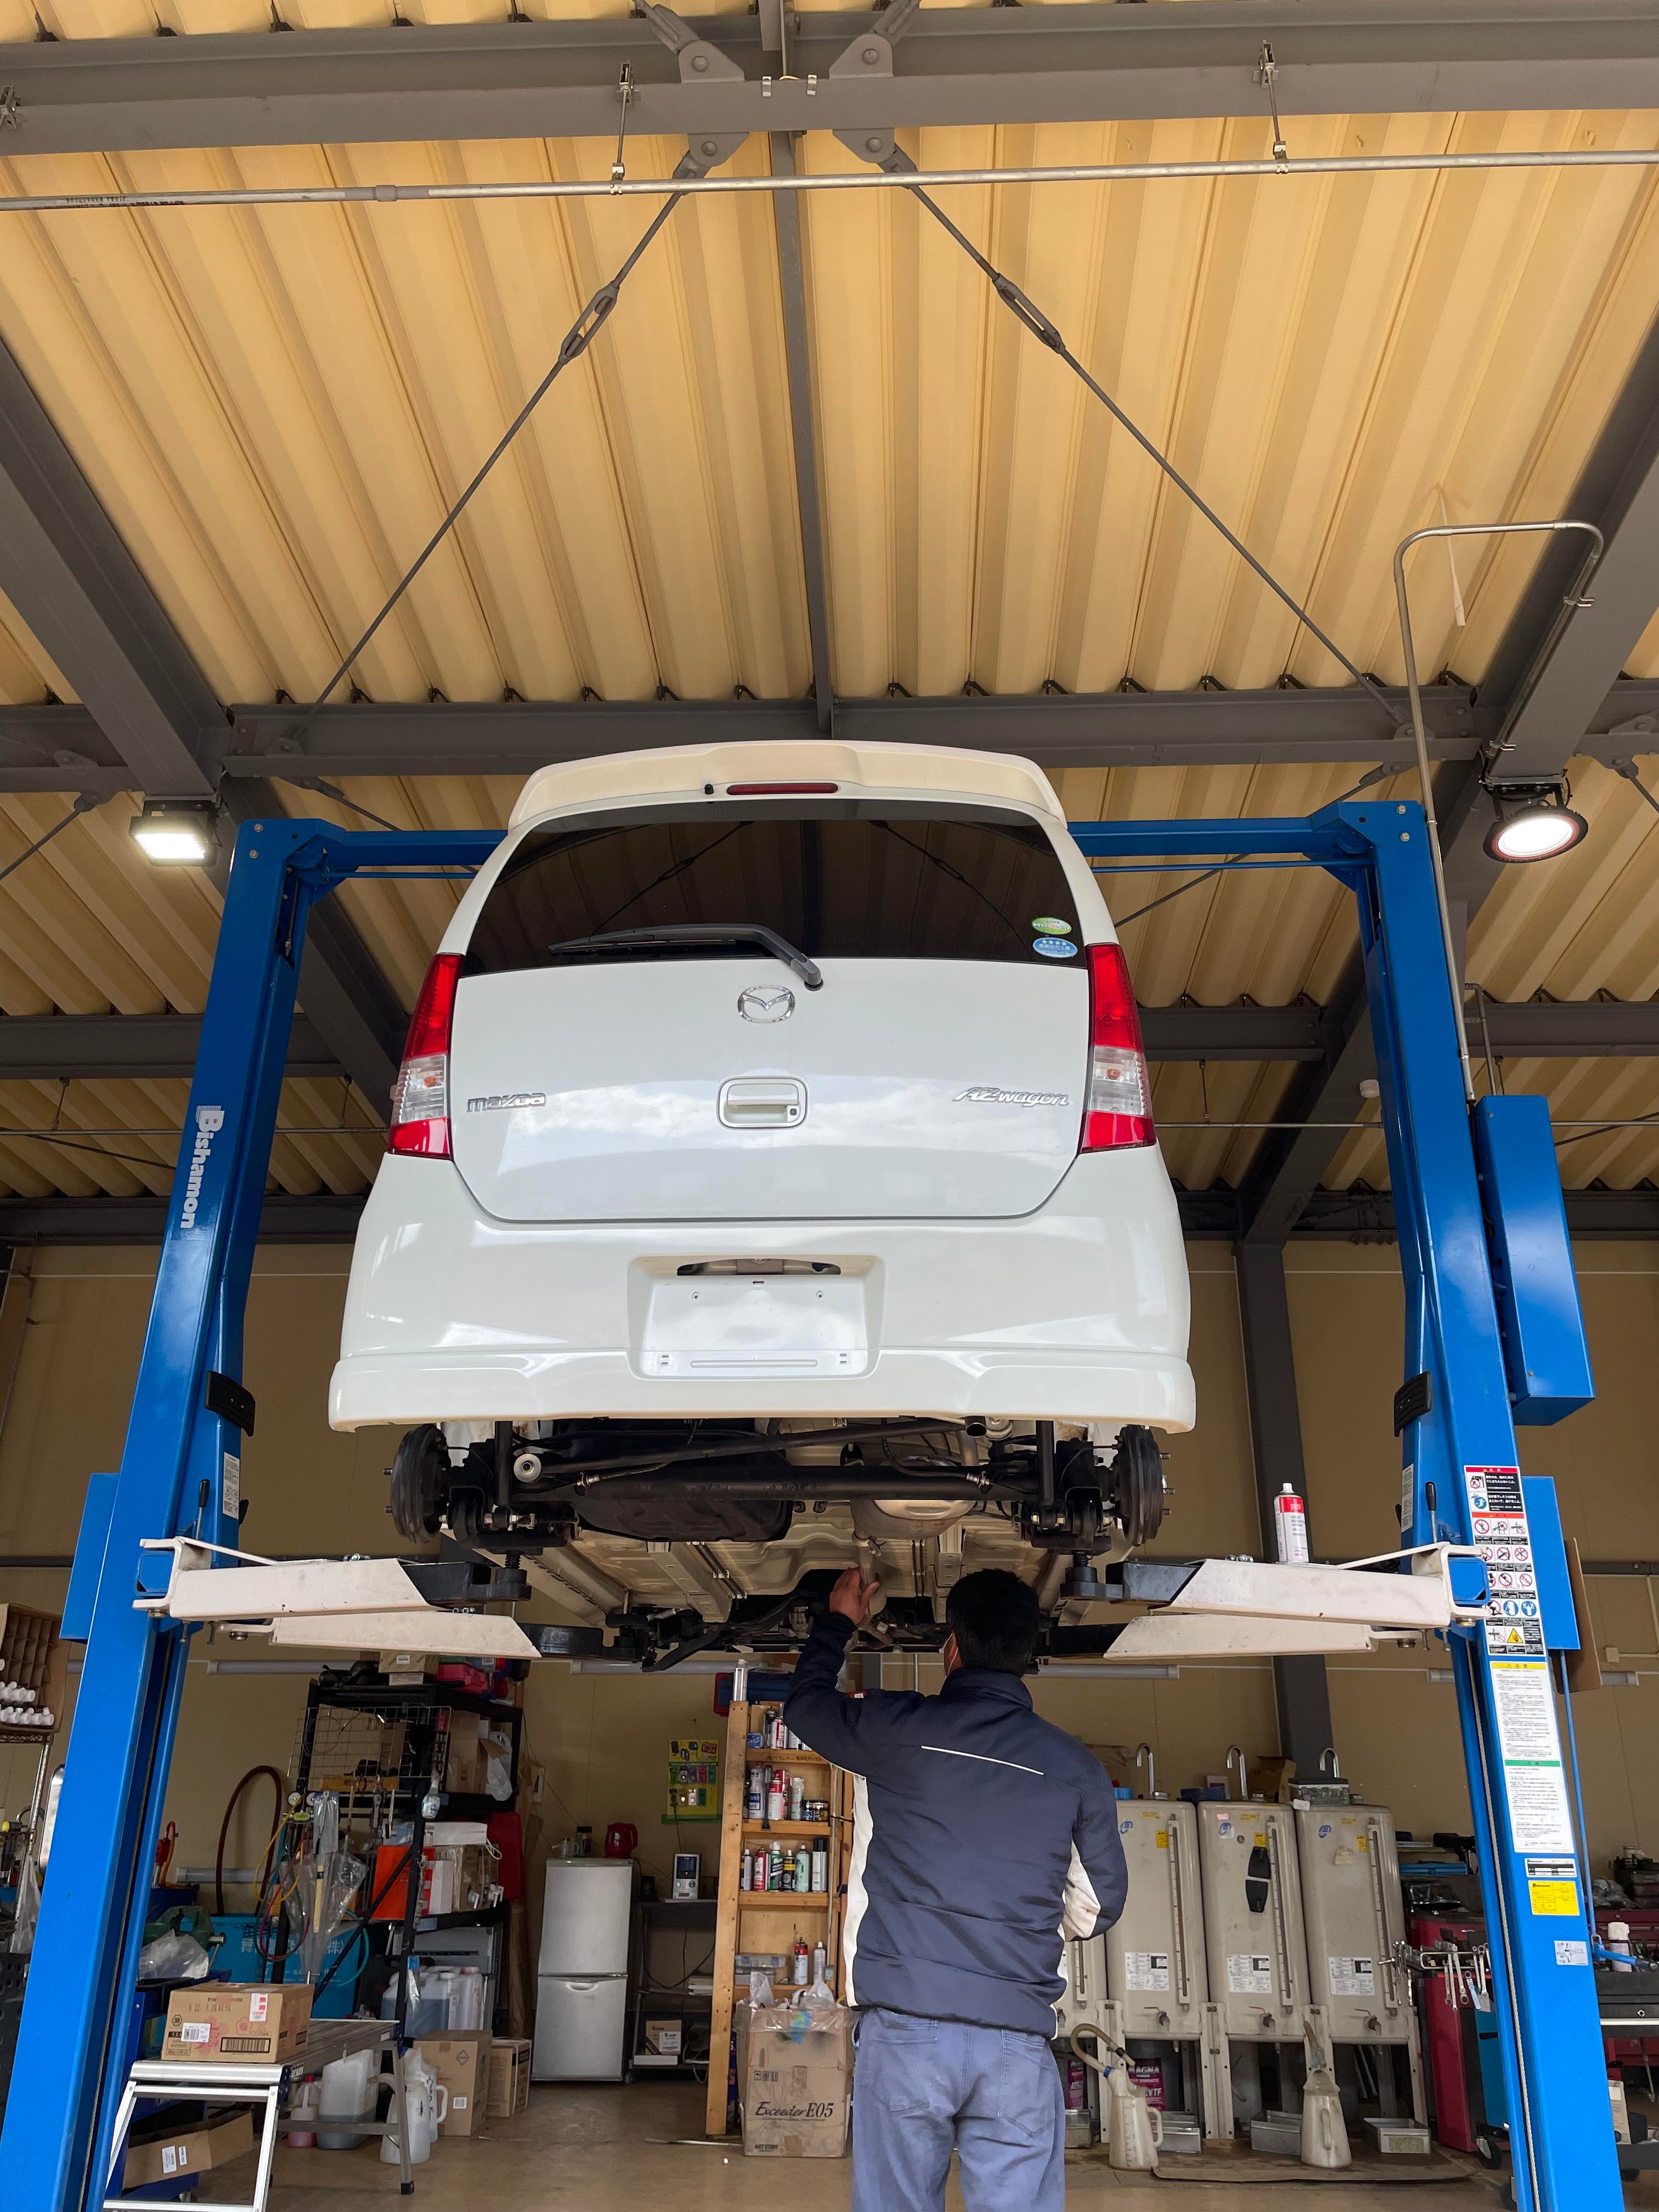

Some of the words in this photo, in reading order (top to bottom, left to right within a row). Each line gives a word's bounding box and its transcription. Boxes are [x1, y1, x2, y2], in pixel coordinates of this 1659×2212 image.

[467, 1092, 546, 1112] mazda
[180, 1105, 225, 1229] Bishamon
[755, 2101, 806, 2117] Exceeder
[805, 2102, 834, 2118] E05
